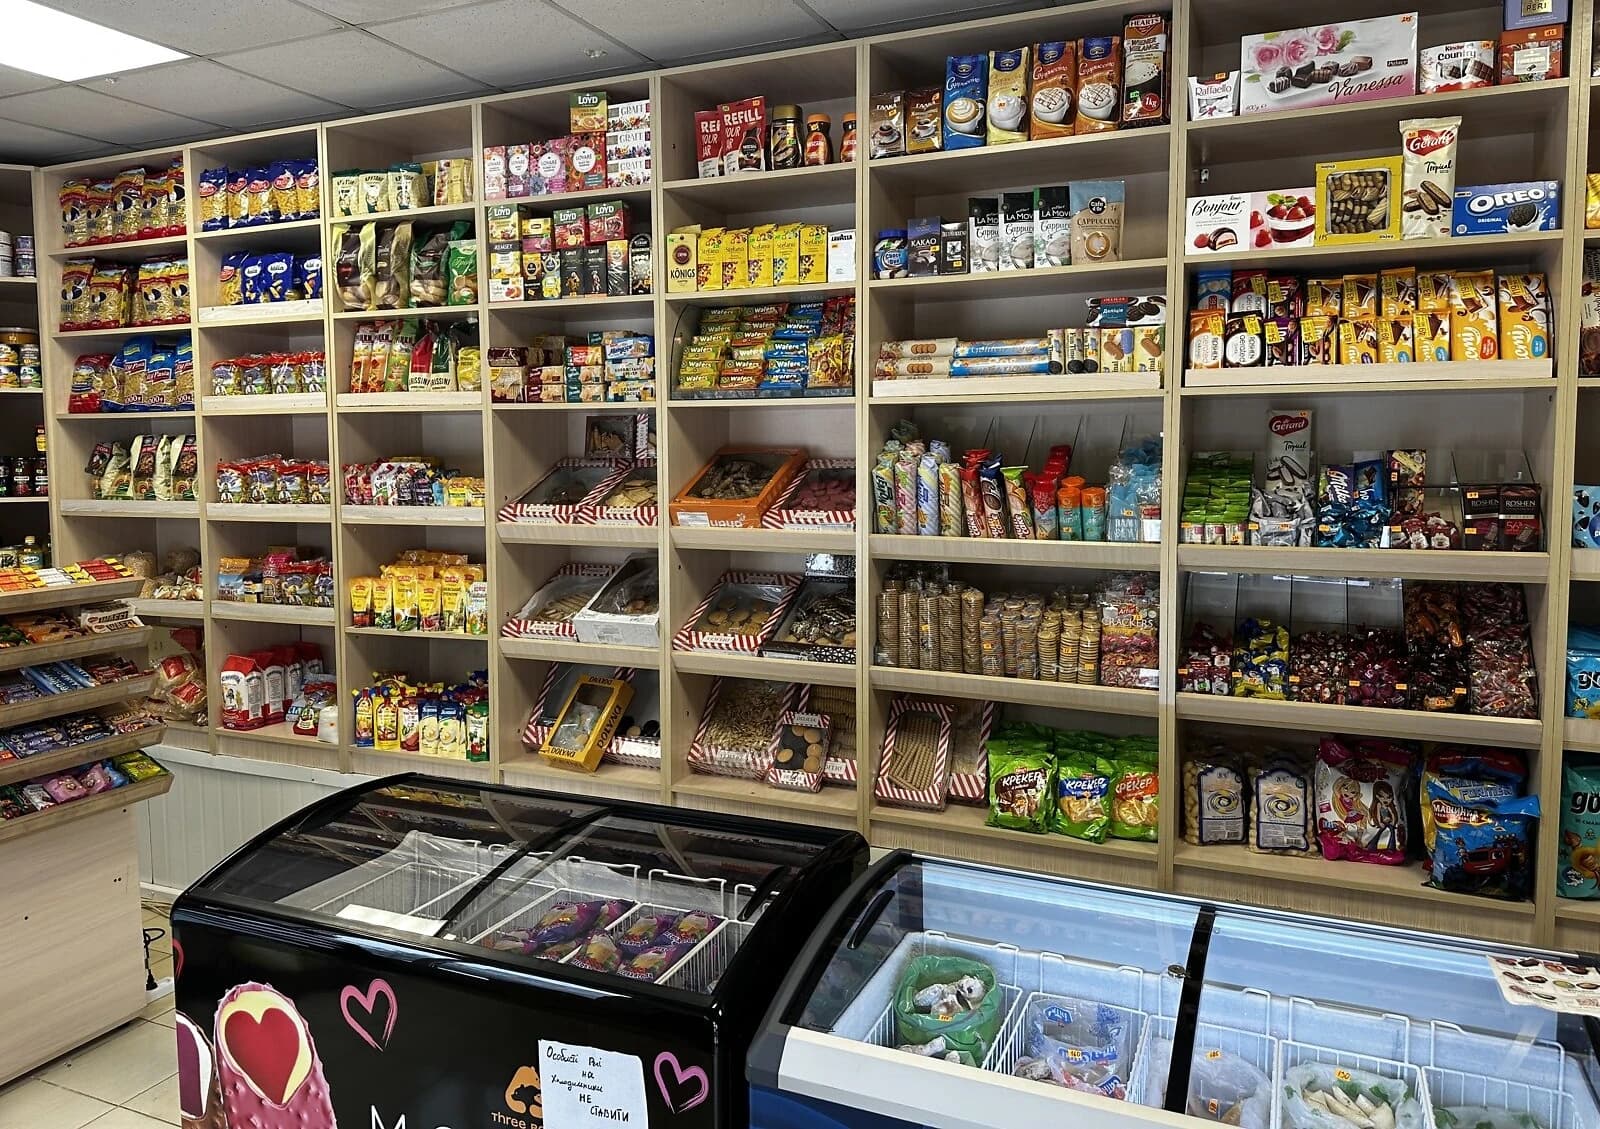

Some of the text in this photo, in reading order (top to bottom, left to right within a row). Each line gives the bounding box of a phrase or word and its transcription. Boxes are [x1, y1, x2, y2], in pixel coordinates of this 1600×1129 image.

[1195, 82, 1232, 97] Raffaello
[1328, 74, 1406, 100] Vanessa
[578, 95, 599, 105] LOYD
[1145, 95, 1157, 107] 1kg
[723, 107, 763, 127] REFILL
[1424, 160, 1453, 174] Tropical
[1470, 188, 1546, 213] OREO
[494, 207, 511, 217] LOYD
[595, 205, 615, 215] LOYD
[1192, 199, 1246, 217] Bonjour
[559, 212, 577, 222] LOYD
[1077, 218, 1120, 226] CAPPUCCINO
[911, 238, 937, 247] KAKAO
[755, 306, 778, 314] Wafers
[786, 323, 809, 331] Wafers
[700, 335, 723, 343] Wafers
[744, 331, 768, 339] Wafers
[690, 346, 713, 354] Wafers
[775, 343, 800, 351] Wafers
[688, 360, 712, 369] Wafers
[735, 360, 760, 369] Wafers
[777, 360, 800, 369] Wafers
[686, 375, 709, 383] Wafers
[730, 375, 754, 383] Wafers
[1505, 499, 1536, 508] ROSHEN
[1101, 616, 1154, 628] CRACKERS
[1002, 772, 1041, 787] КРЕКЕР
[1065, 777, 1105, 791] КРЕКЕР
[581, 1070, 595, 1079] на
[579, 1093, 592, 1103] НЕ
[590, 1105, 629, 1122] СТАВИТИ
